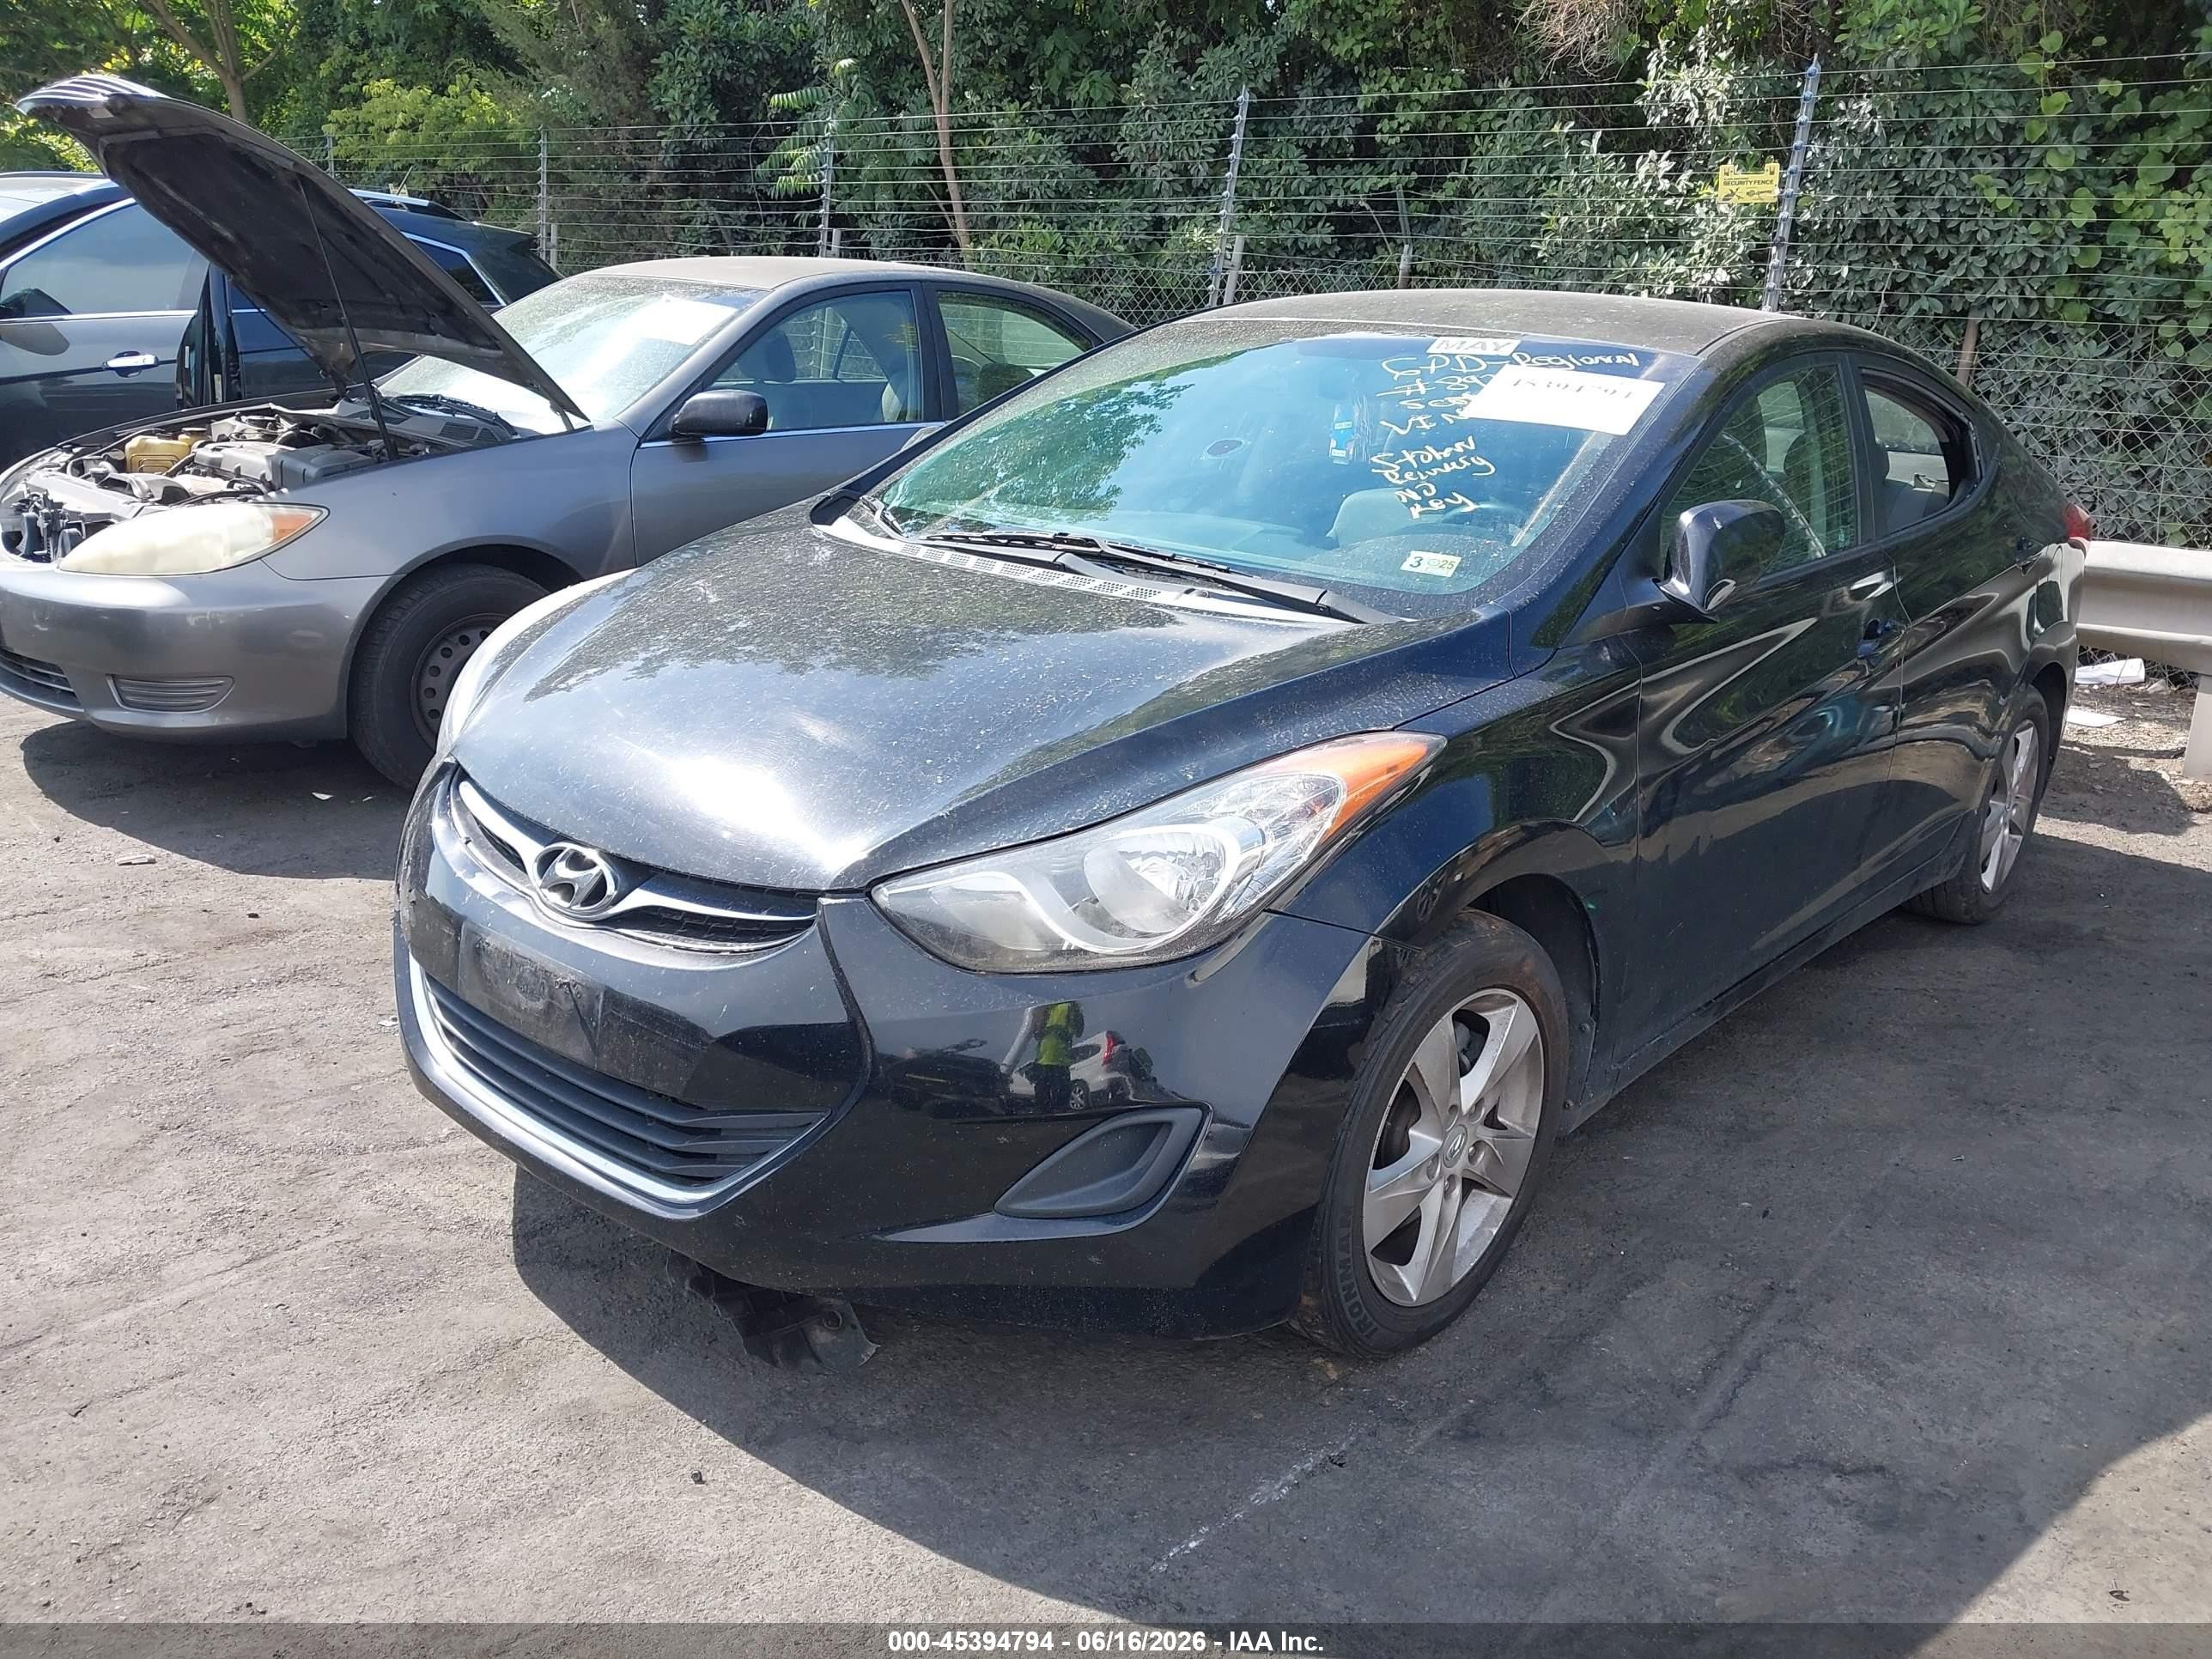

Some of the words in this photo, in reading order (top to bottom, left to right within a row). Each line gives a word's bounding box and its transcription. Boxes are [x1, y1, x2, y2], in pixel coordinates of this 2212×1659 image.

[1435, 340, 1513, 351] MAY
[1409, 556, 1424, 568] 3
[1438, 559, 1456, 570] 25
